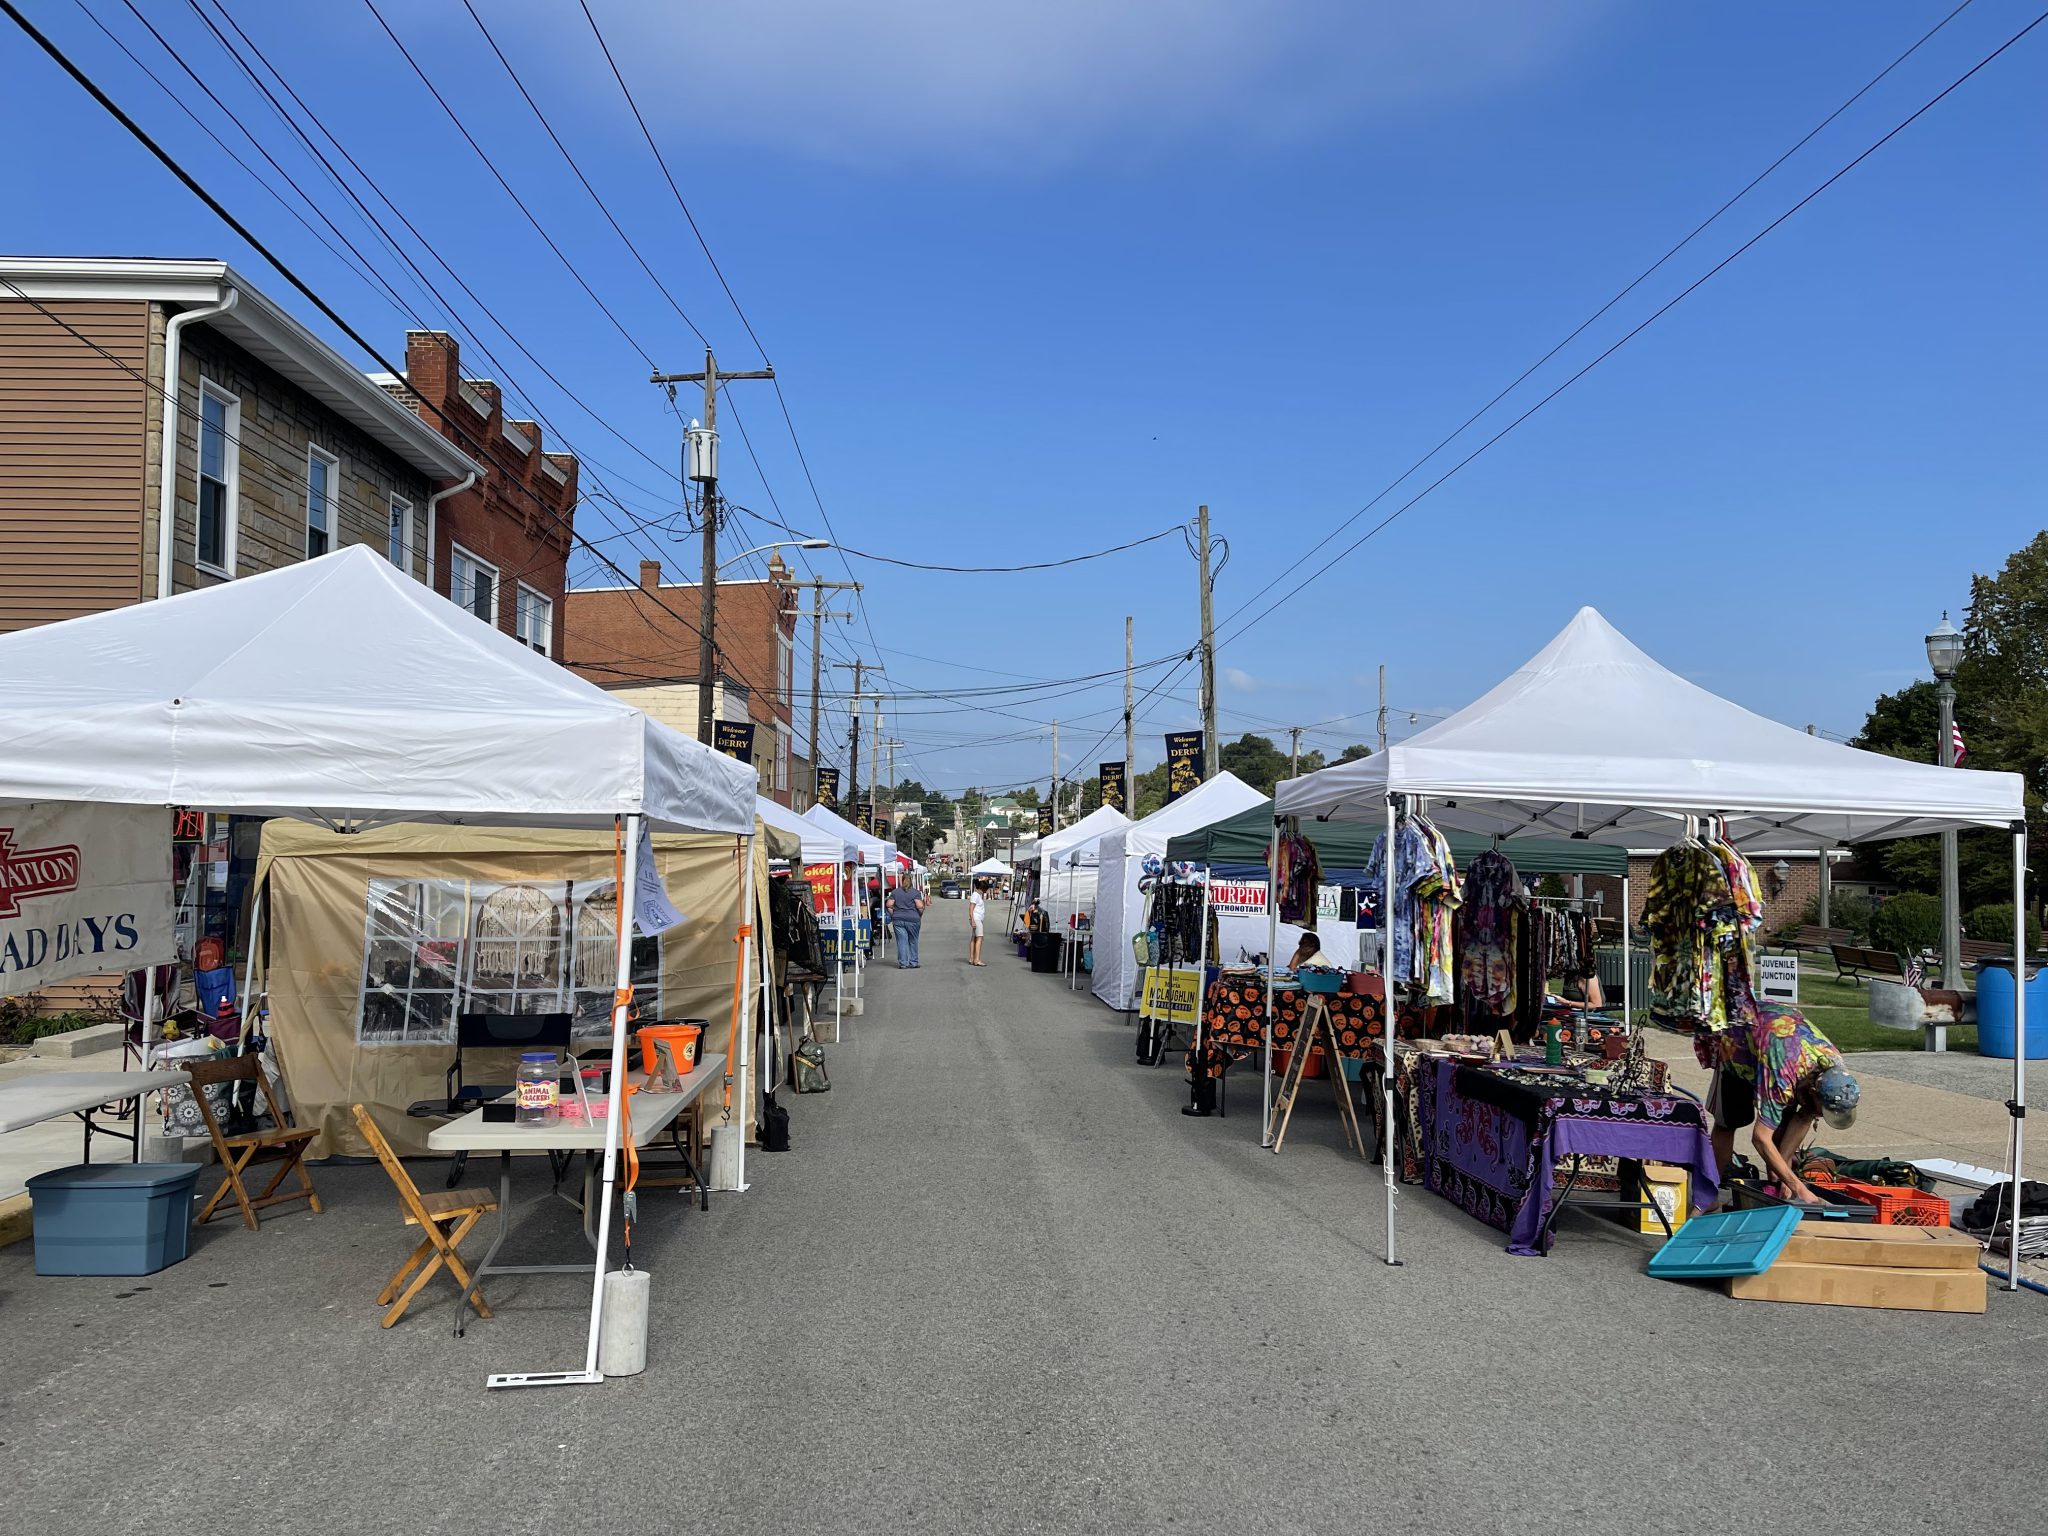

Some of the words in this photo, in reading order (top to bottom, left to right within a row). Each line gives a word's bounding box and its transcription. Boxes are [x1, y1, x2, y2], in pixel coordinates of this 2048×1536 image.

[722, 726, 747, 734] Welcome
[718, 738, 749, 749] DERRY
[1171, 747, 1200, 757] DERRY
[54, 913, 139, 963] DAYS
[1761, 959, 1795, 969] JUVENILE
[1761, 971, 1796, 981] JUNCTION
[523, 1087, 550, 1095] ANIMAL
